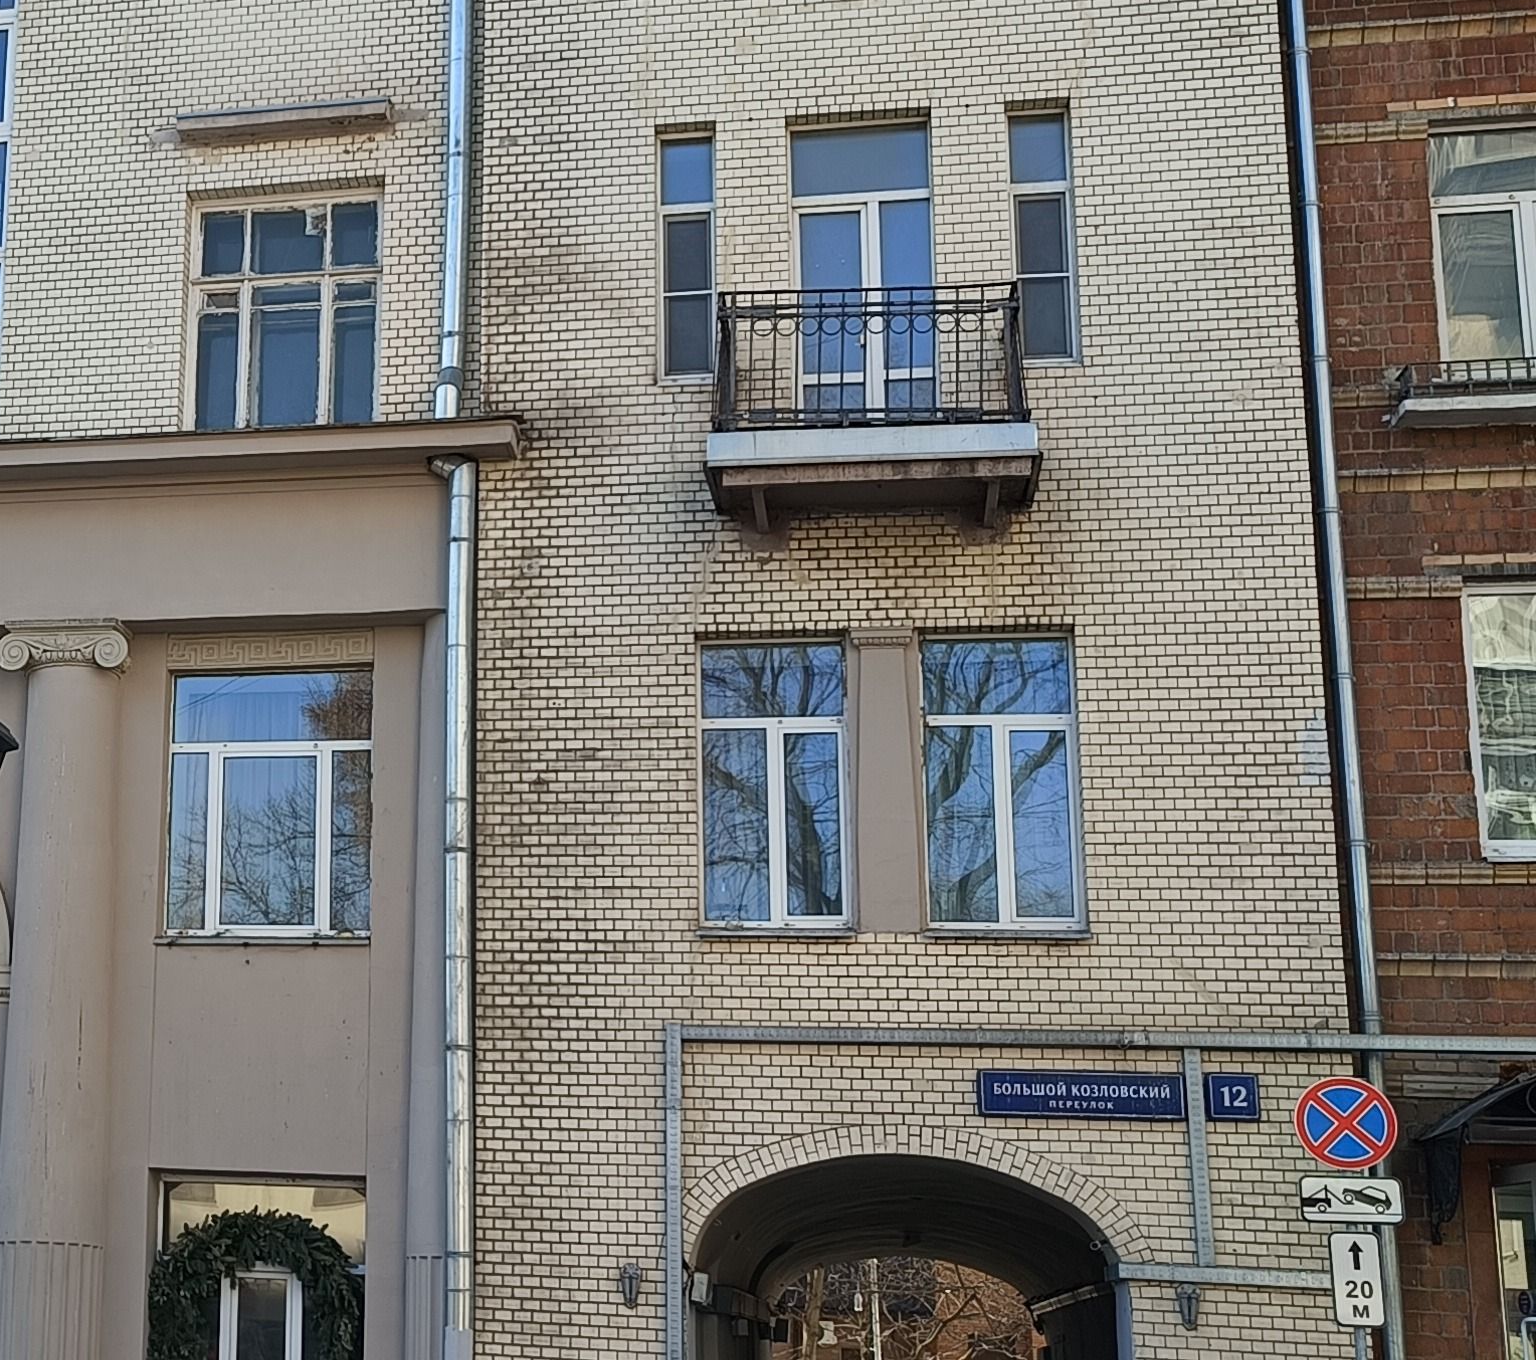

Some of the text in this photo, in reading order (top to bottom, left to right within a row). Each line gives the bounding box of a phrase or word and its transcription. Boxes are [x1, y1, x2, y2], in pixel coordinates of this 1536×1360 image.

[993, 1081, 1171, 1099] БОЛЬШОЙ КОЗЛОВСКИЙ
[1219, 1085, 1248, 1107] 12
[1049, 1100, 1115, 1110] ПЕРЕУЛОК
[1344, 1280, 1374, 1299] 20
